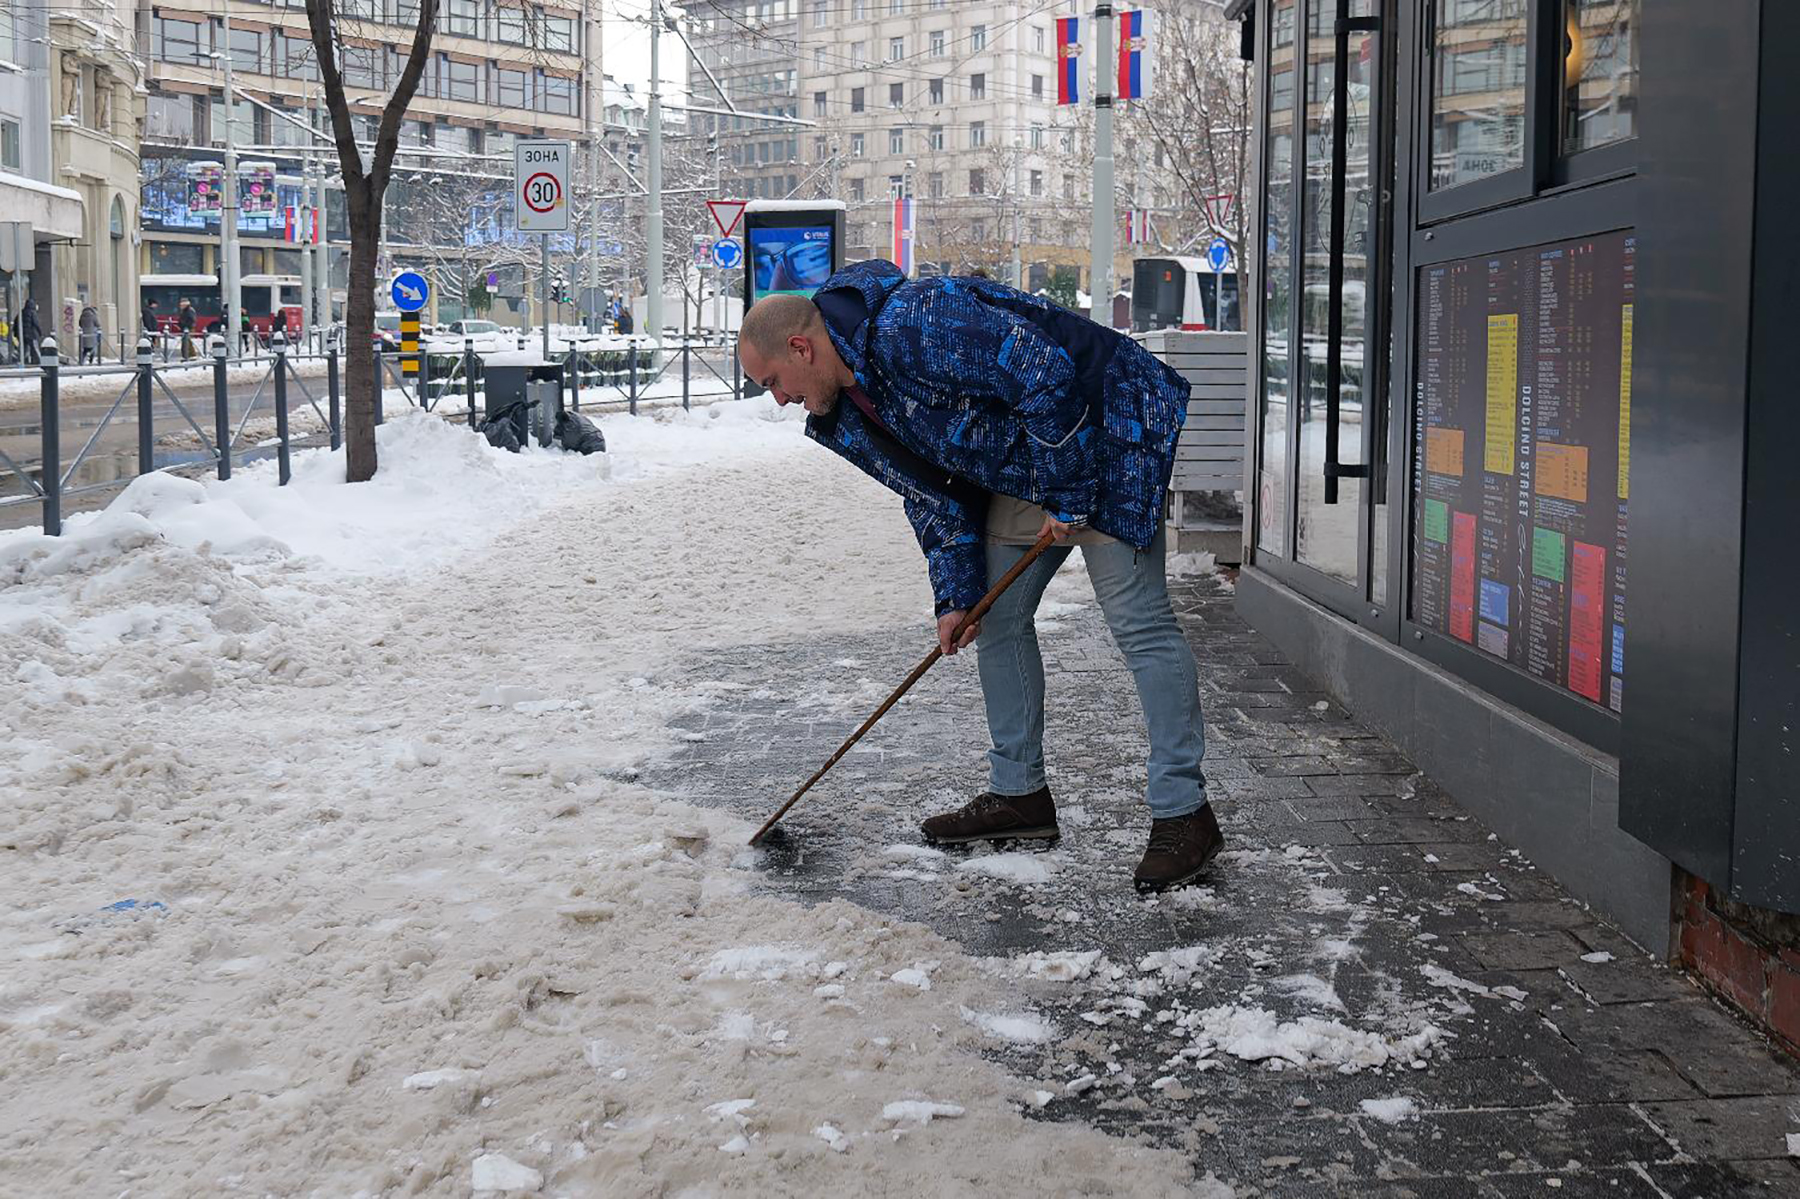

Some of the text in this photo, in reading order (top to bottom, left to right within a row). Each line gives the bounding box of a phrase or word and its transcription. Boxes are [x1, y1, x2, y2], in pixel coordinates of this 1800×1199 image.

[525, 150, 559, 163] ЗОНА
[531, 182, 554, 203] 30
[1416, 382, 1424, 441] DOLCINO
[1520, 385, 1532, 455] DOLCINO
[1414, 445, 1423, 494] STREET
[1518, 461, 1529, 517] STREET
